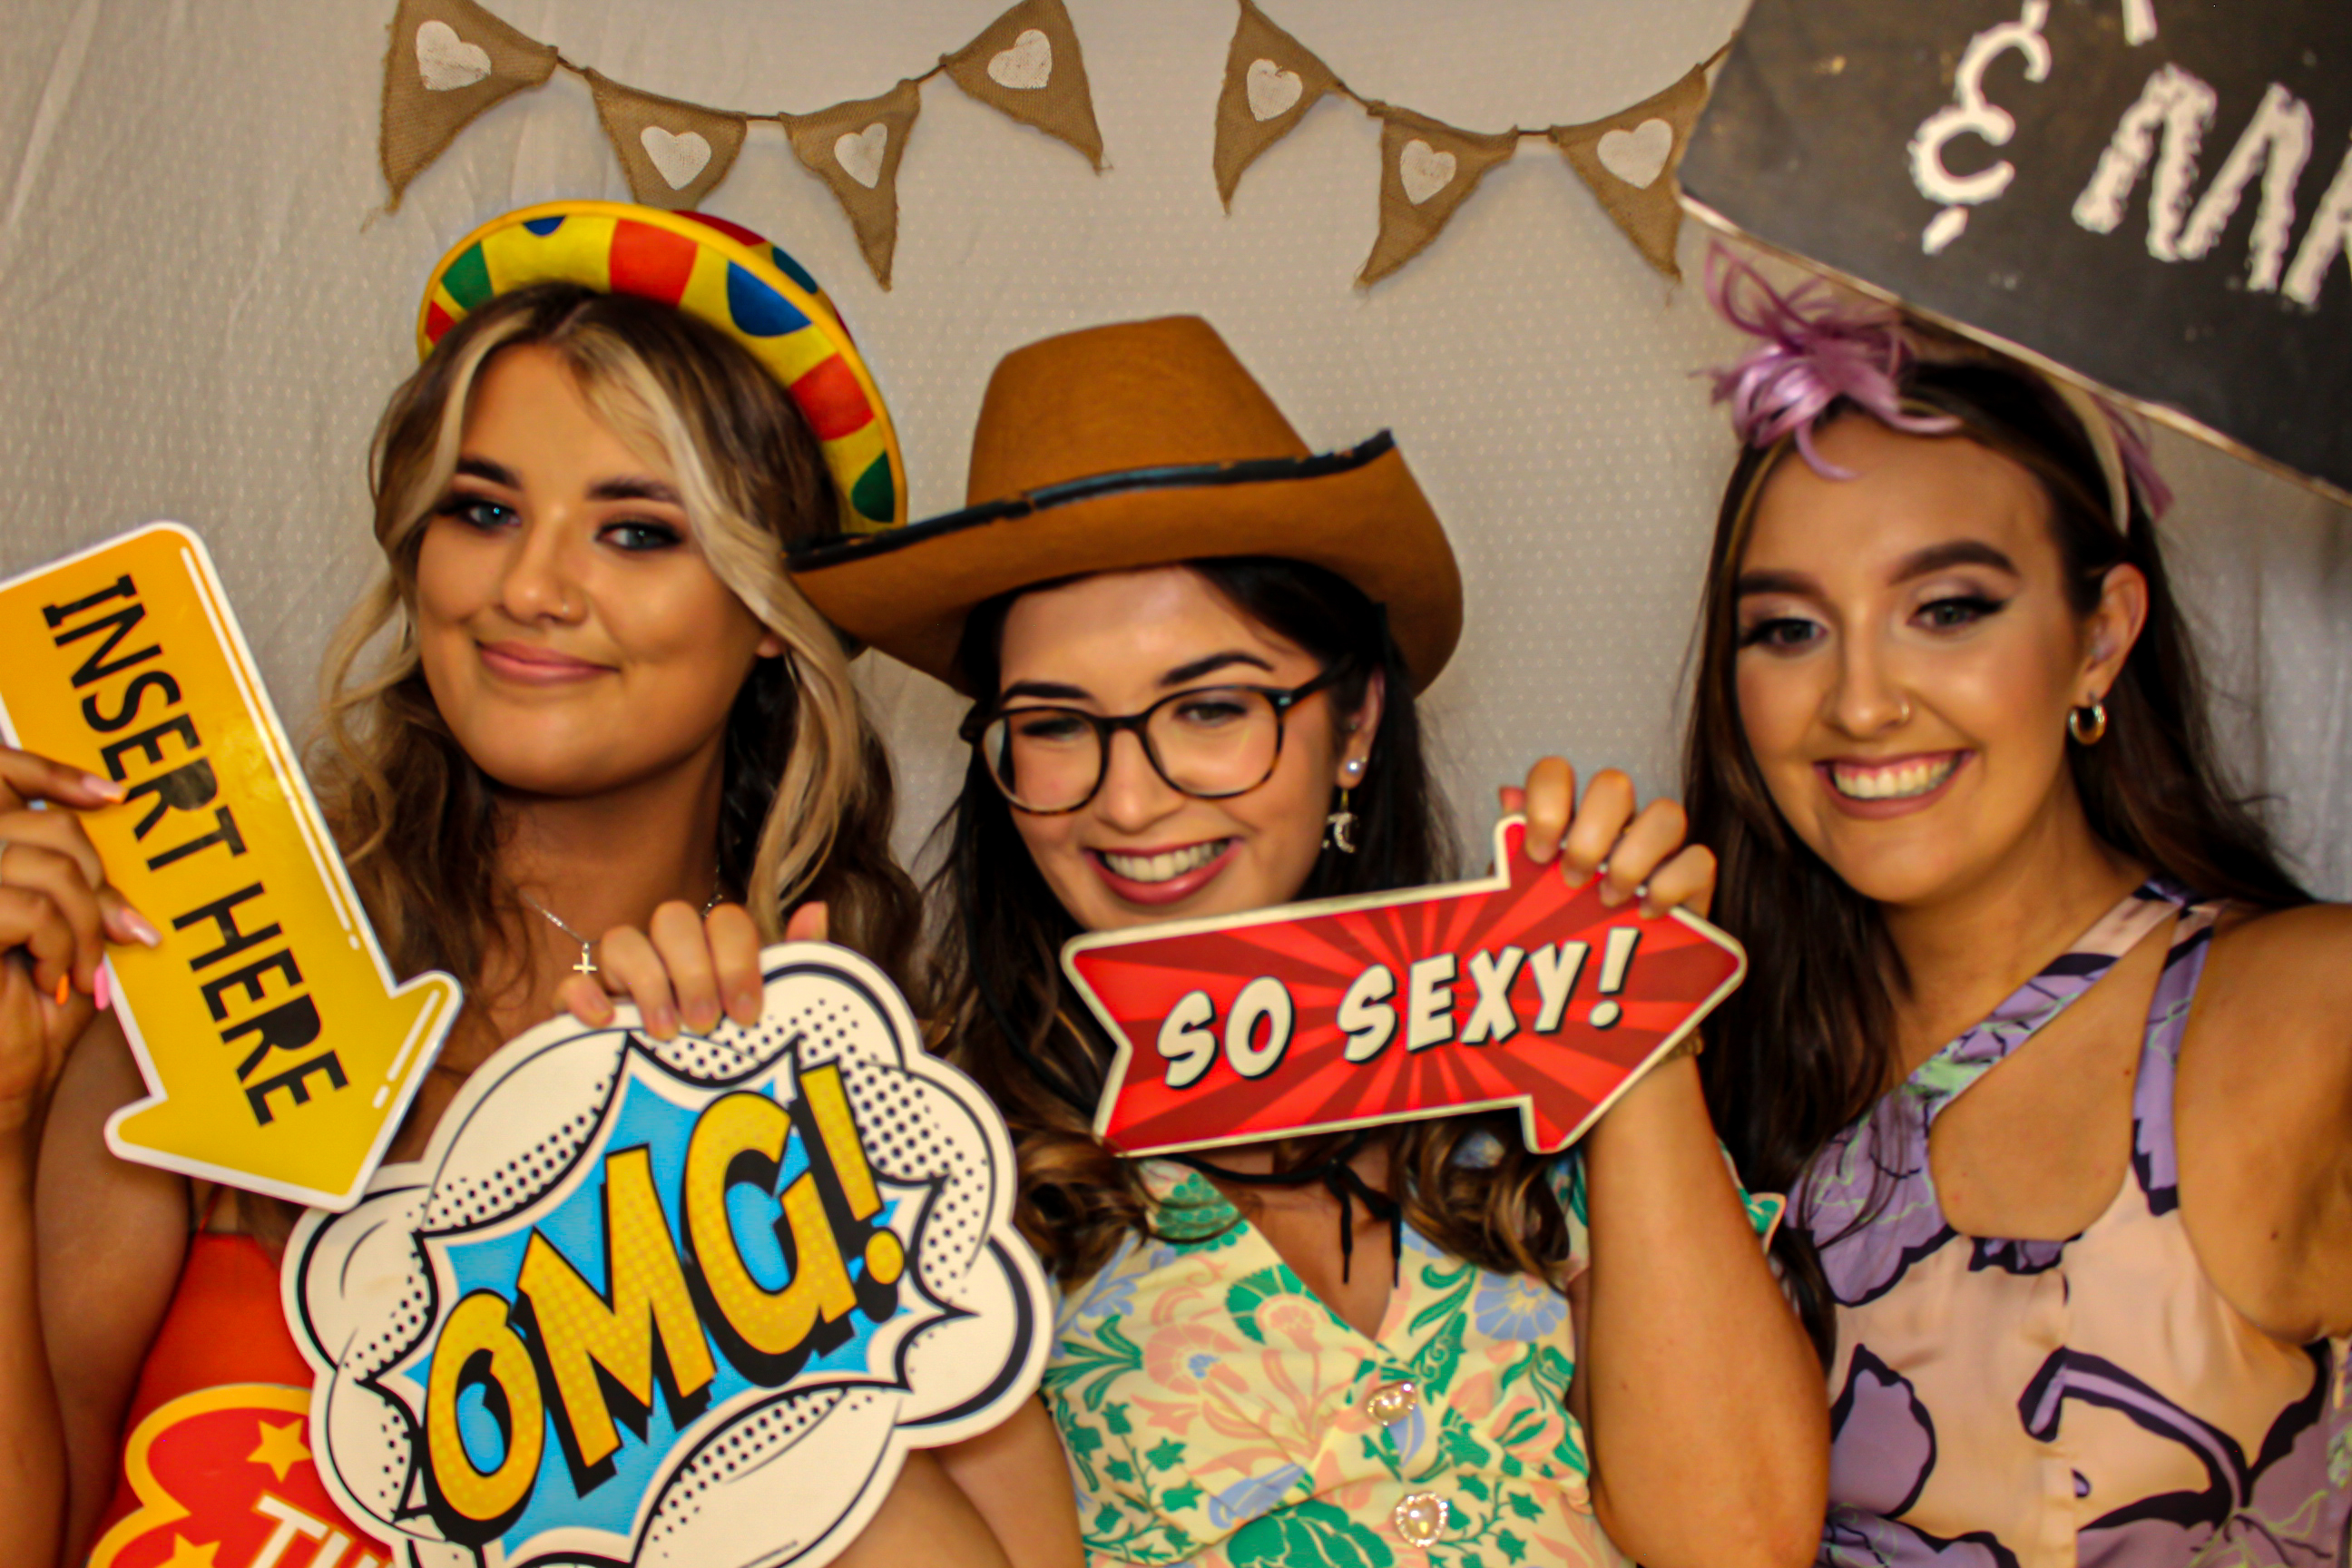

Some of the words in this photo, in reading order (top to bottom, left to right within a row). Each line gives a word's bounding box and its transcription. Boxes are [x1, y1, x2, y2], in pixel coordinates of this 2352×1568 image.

[42, 573, 248, 872] INSERT
[171, 880, 351, 1128] HERE
[1156, 975, 1292, 1088] SO
[1337, 926, 1639, 1063] SEXY!
[426, 1062, 906, 1534] OMG!
